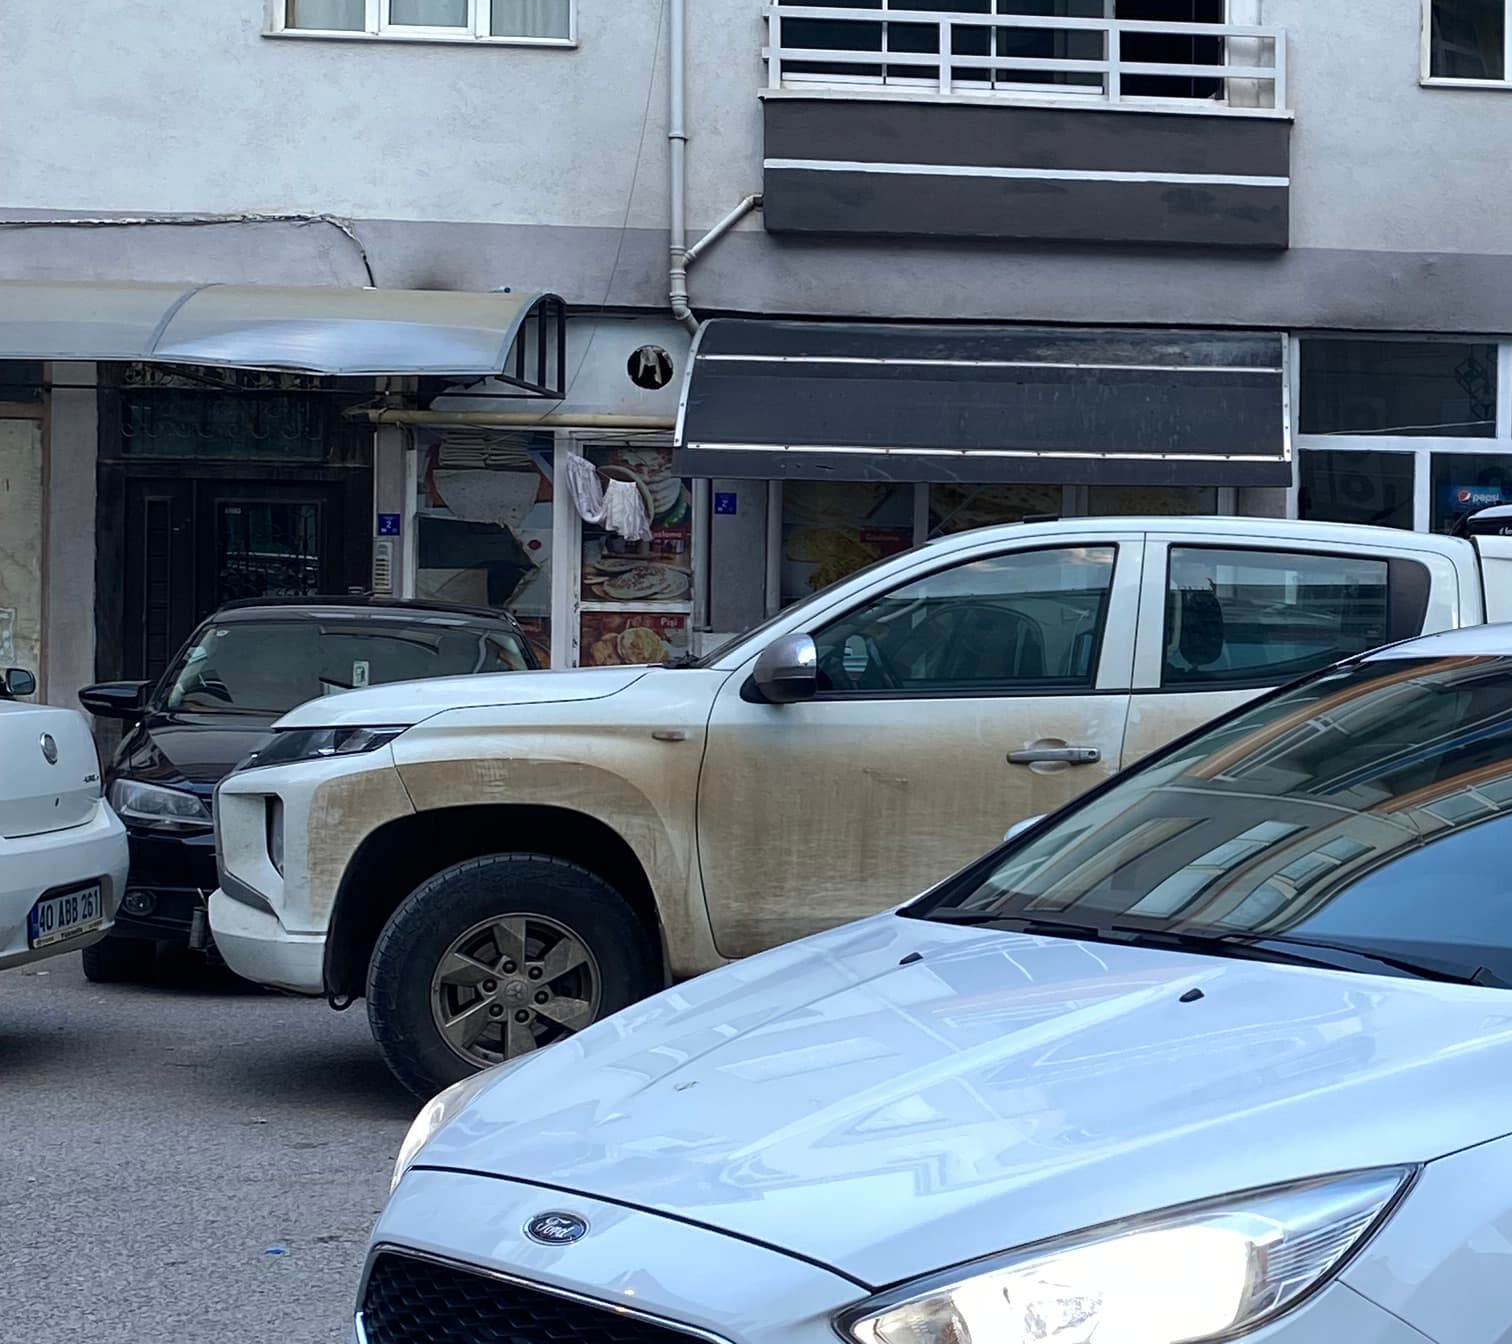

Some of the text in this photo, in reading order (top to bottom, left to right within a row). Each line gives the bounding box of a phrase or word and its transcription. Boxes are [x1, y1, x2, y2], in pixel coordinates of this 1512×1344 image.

[1473, 494, 1500, 505] pepsi
[40, 889, 98, 932] 40 ABB 261
[535, 1216, 577, 1239] Ford
